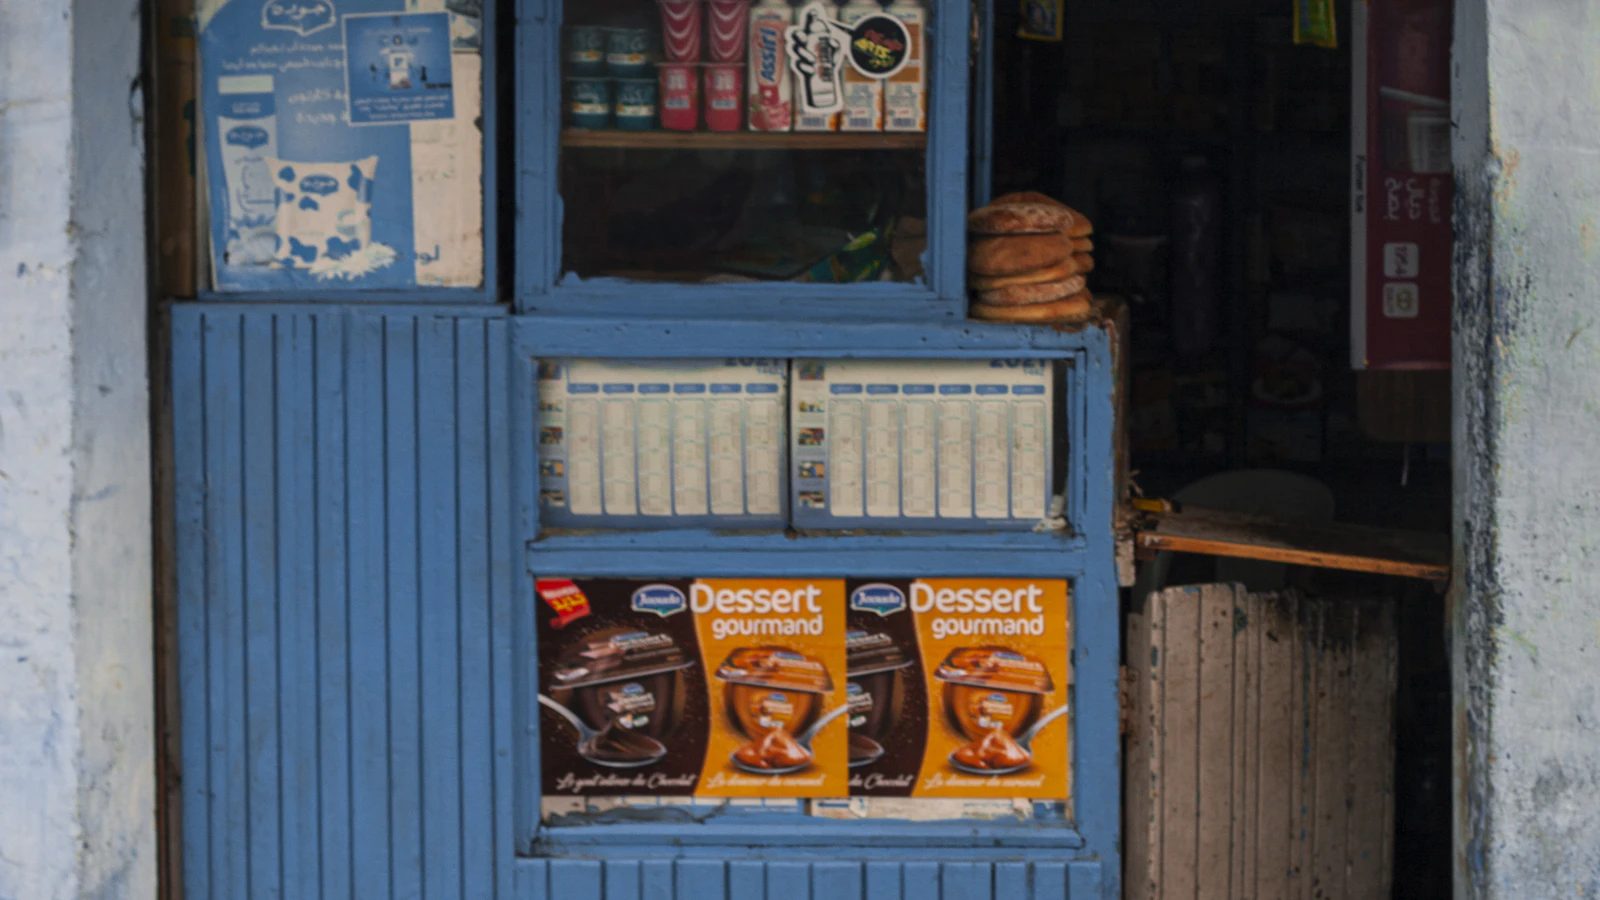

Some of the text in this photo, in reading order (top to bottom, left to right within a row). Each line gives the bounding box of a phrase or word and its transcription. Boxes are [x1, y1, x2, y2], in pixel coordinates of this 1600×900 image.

[689, 583, 822, 614] Dessert
[909, 582, 1044, 614] Dessert
[712, 614, 824, 640] gourmand
[931, 614, 1045, 640] gourmand
